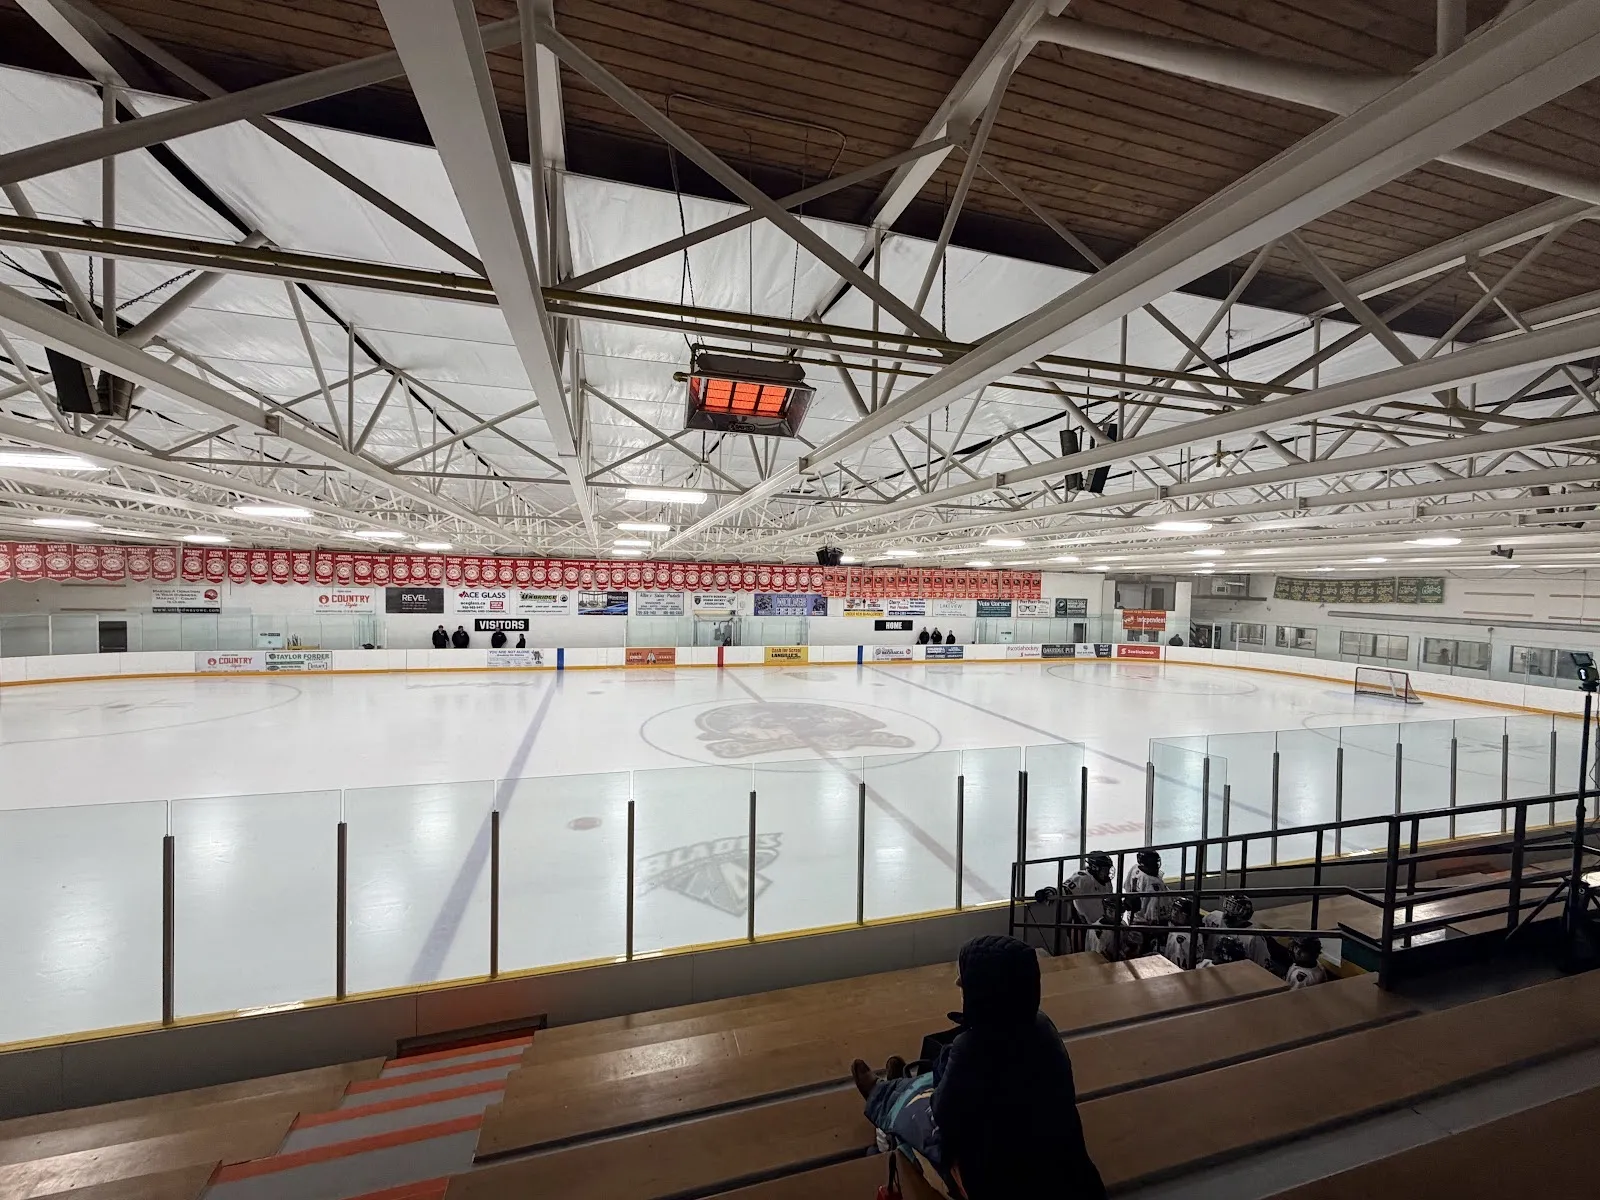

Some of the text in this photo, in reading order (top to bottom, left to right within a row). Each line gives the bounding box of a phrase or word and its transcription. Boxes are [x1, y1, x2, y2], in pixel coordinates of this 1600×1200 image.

[331, 594, 370, 603] COUNTRY
[464, 591, 506, 599] ACE GLASS
[479, 620, 525, 630] VISITORS
[885, 621, 903, 630] HOME
[218, 657, 253, 665] COUNTRY
